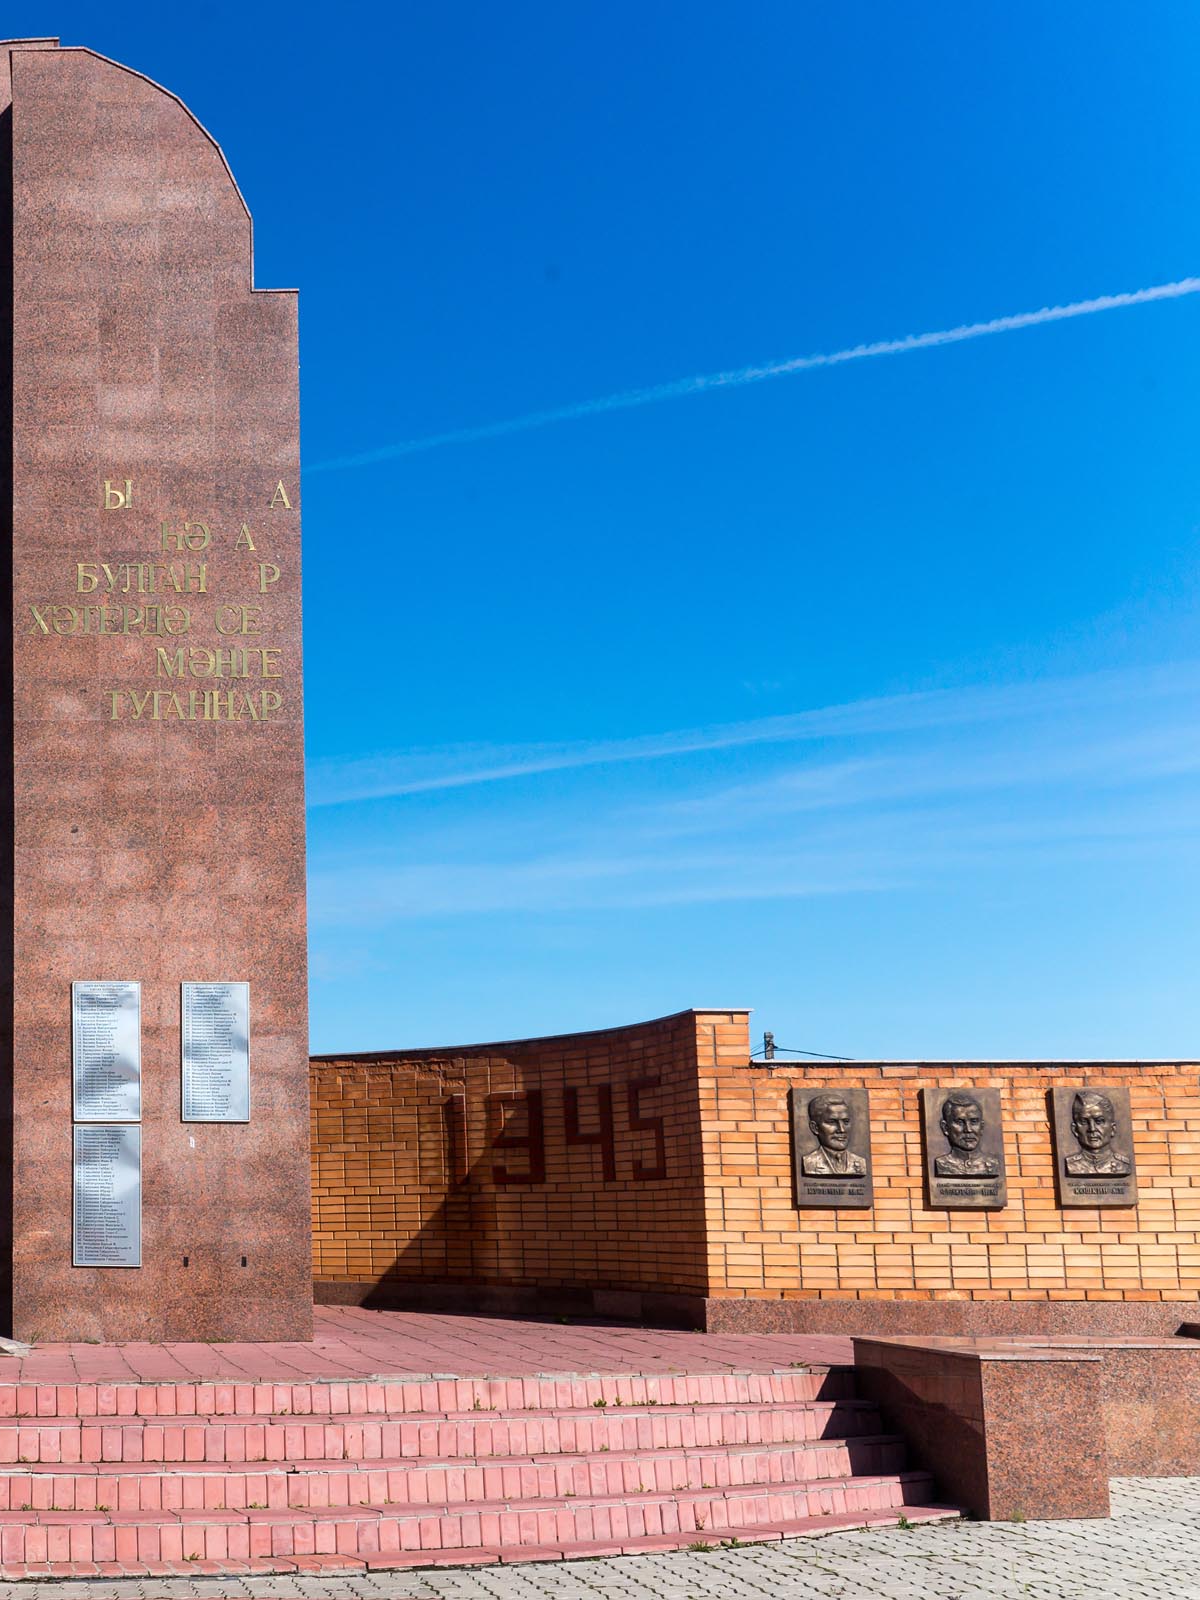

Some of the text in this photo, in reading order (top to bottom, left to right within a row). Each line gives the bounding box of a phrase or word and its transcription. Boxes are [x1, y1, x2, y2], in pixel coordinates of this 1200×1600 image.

[104, 479, 292, 510] Ы А
[234, 522, 257, 551] А
[76, 563, 281, 593] БУЛГАН Р
[29, 604, 263, 638] ХӘТЕРДӘ СЕ
[104, 690, 282, 721] ТУГАННАР
[447, 1076, 667, 1185] 1945
